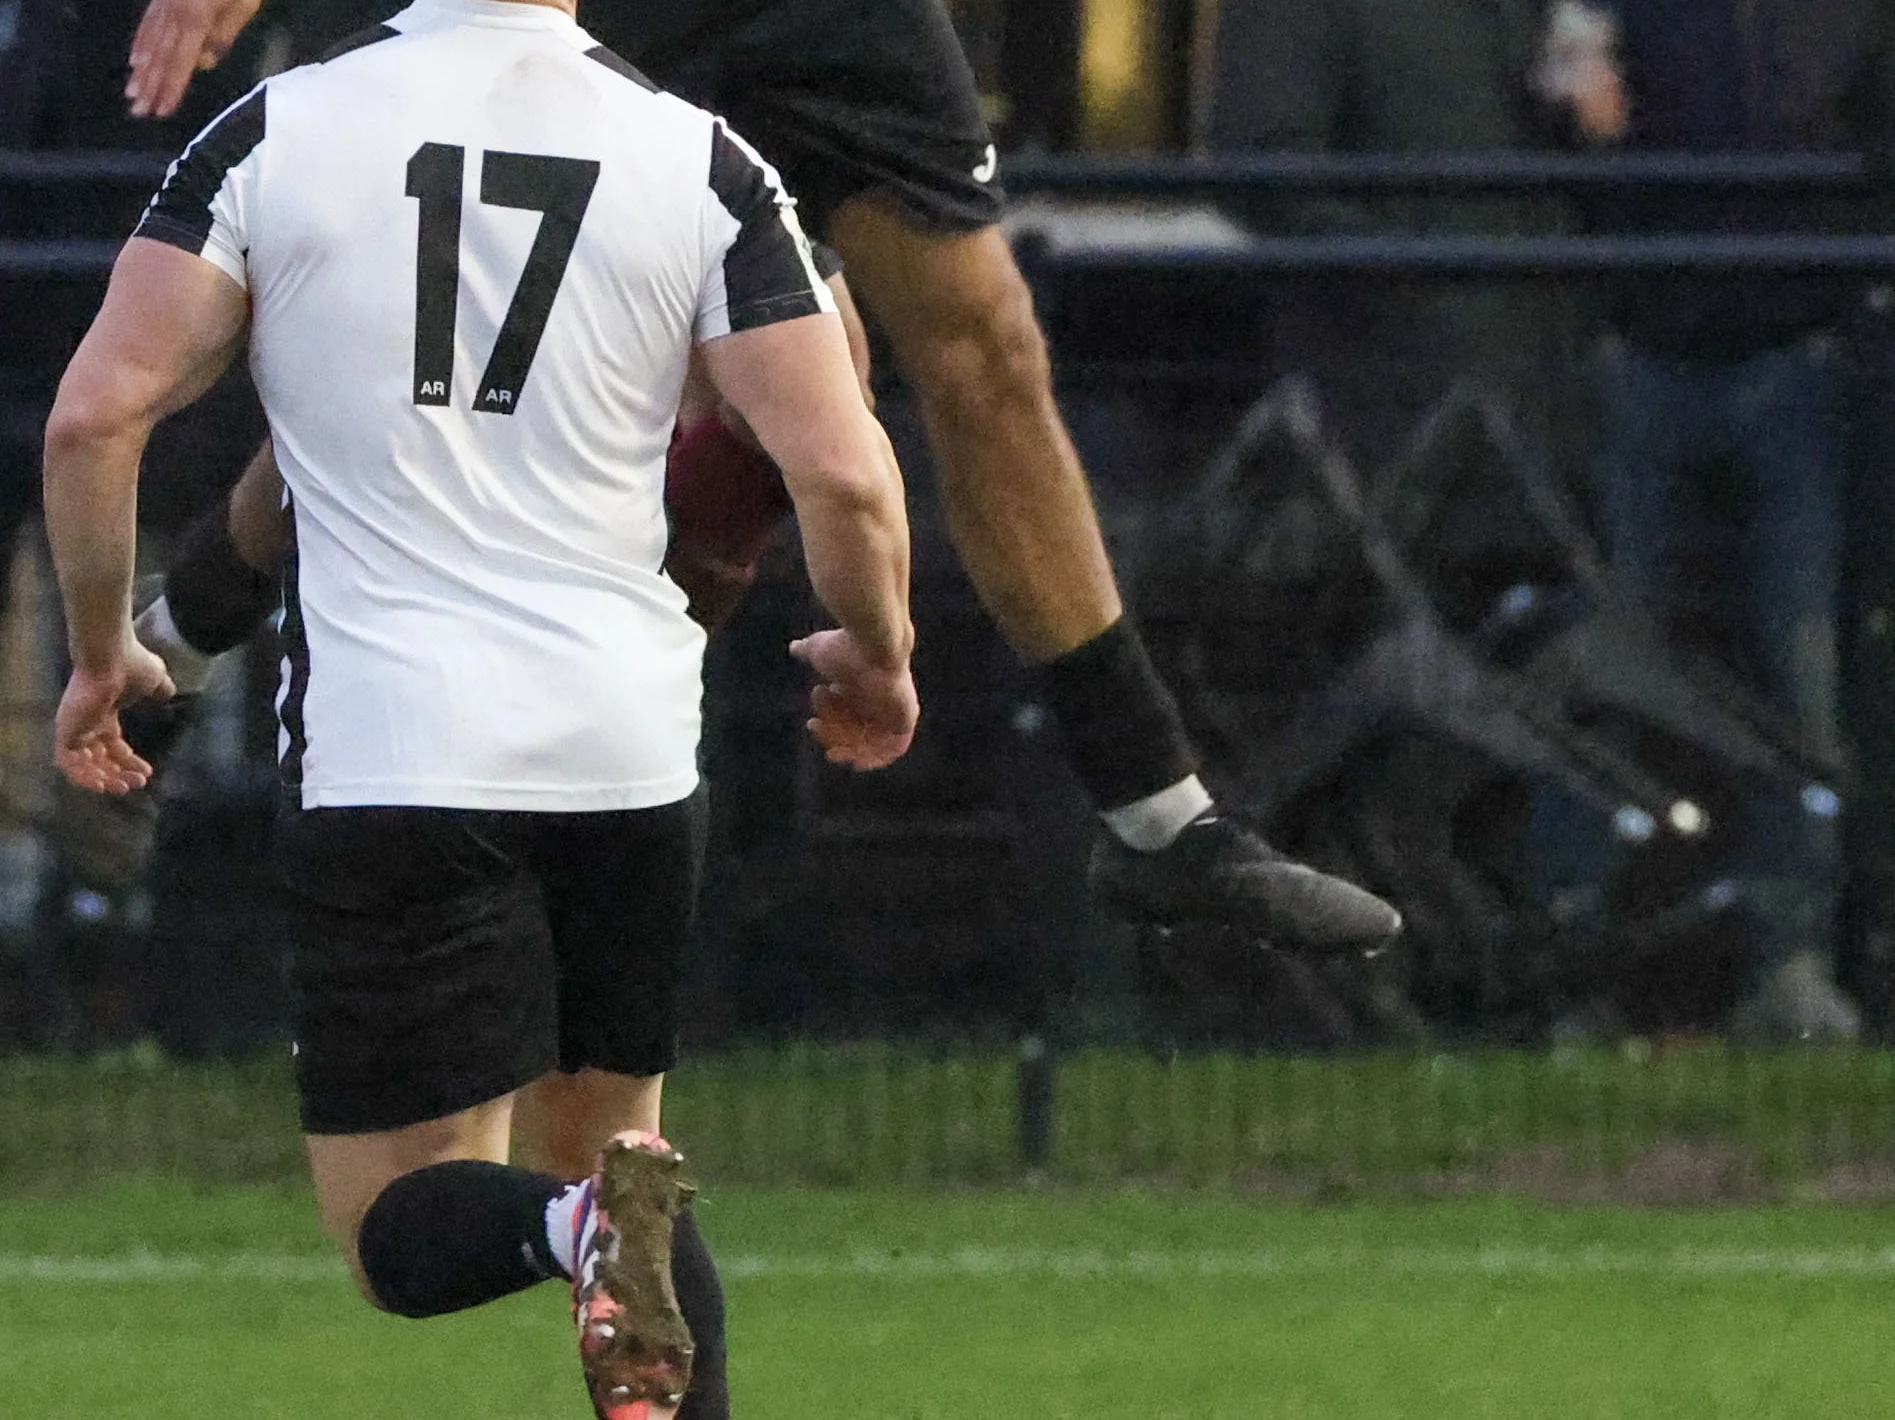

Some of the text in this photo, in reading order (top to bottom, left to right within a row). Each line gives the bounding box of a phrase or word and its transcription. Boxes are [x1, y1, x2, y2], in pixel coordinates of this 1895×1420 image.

[405, 141, 600, 415] 17
[420, 380, 445, 396] AR
[485, 388, 511, 404] AR
